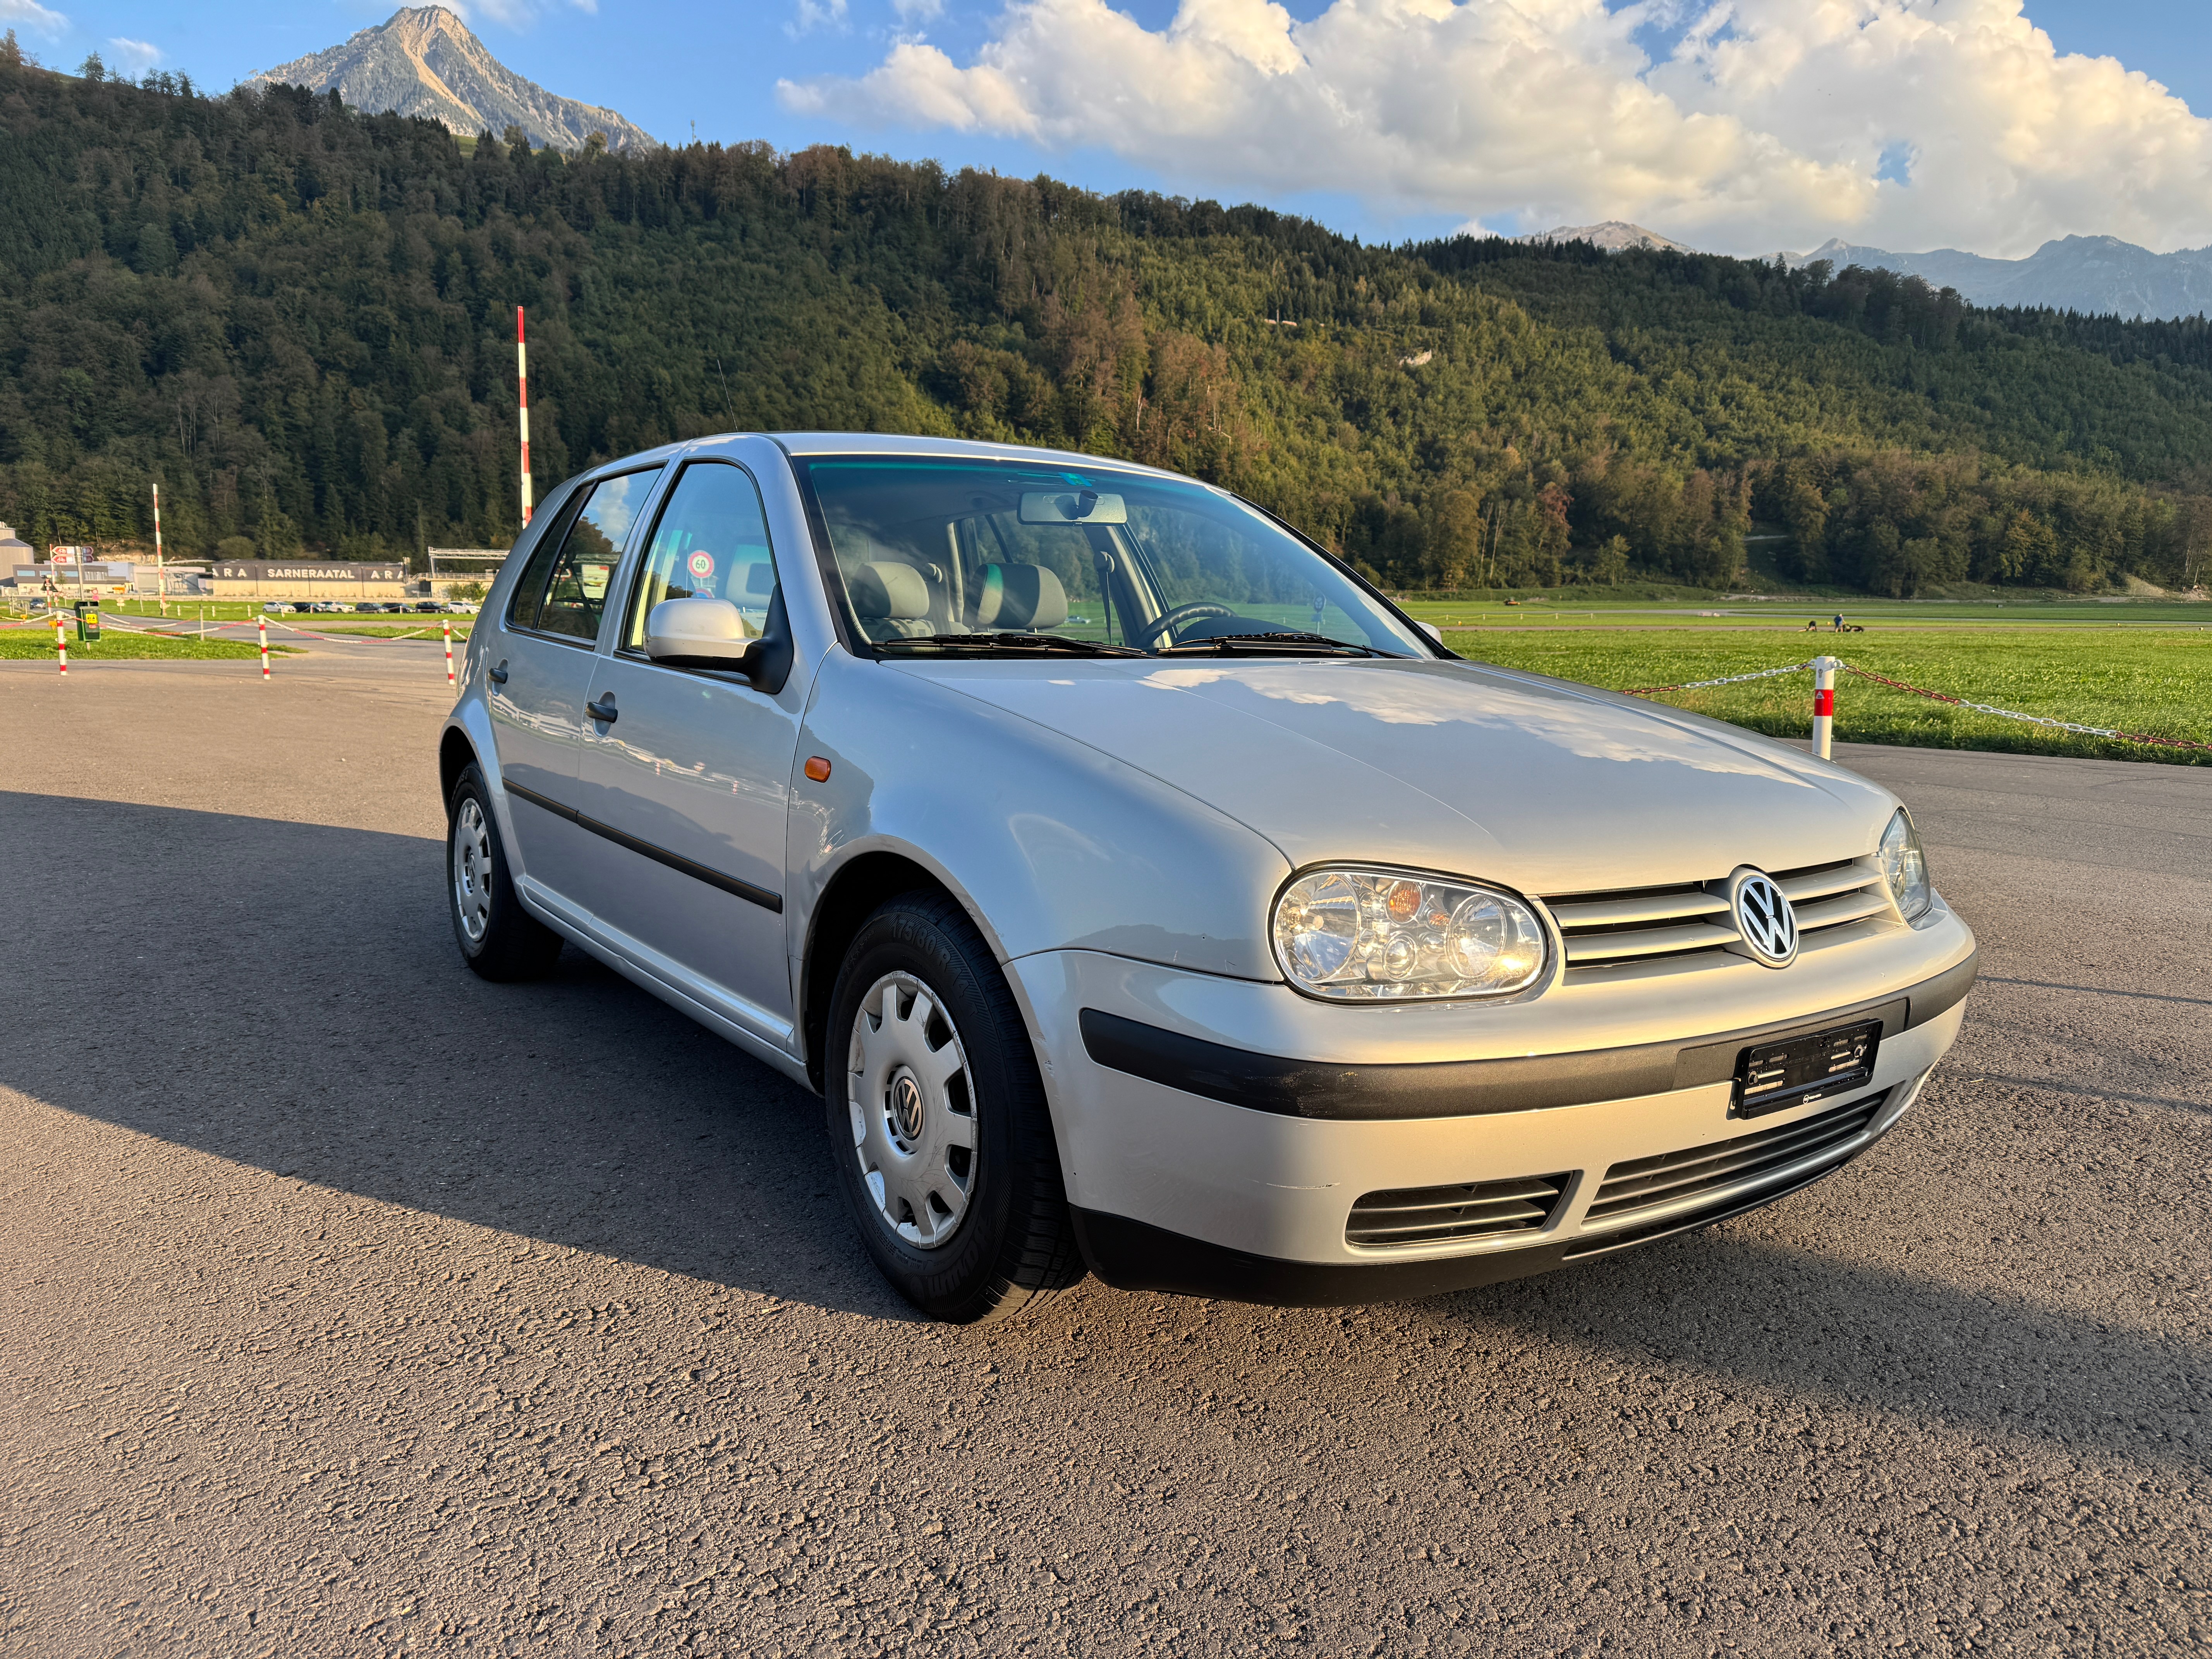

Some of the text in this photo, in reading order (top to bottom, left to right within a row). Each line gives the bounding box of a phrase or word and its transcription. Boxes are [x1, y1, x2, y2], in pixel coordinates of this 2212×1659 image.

[267, 568, 356, 579] SARNERAATAL
[696, 560, 706, 569] 60
[1739, 876, 1796, 958] VW
[891, 919, 937, 956] 175/80
[895, 1079, 922, 1138] VW
